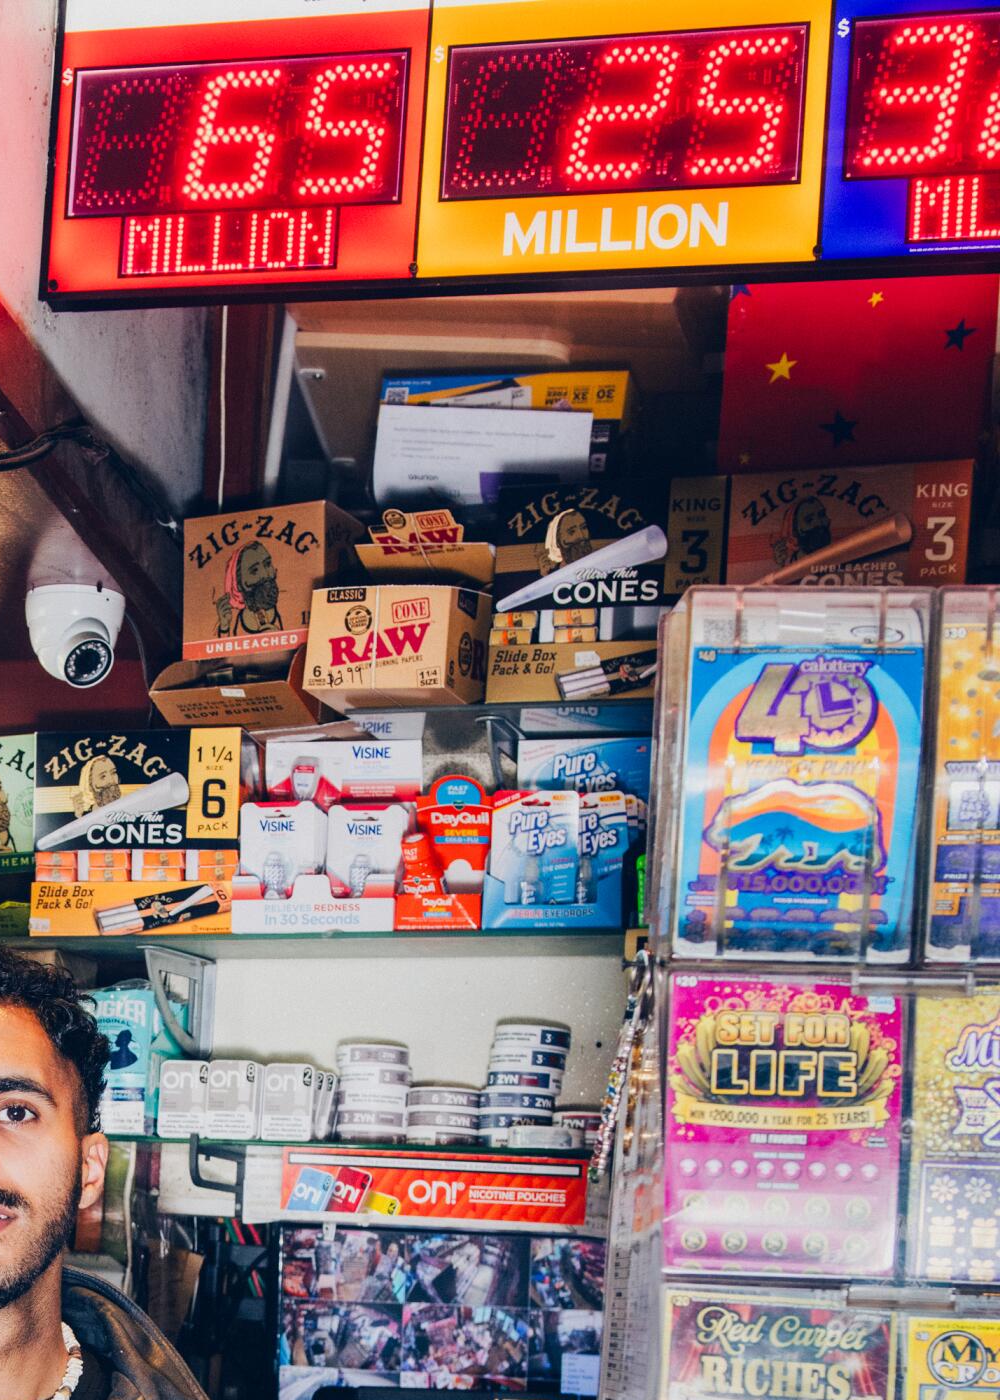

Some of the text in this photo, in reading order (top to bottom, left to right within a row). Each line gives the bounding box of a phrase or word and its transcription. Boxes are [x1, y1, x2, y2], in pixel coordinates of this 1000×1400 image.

[563, 37, 794, 182] 25
[63, 62, 393, 200] $ 65
[502, 203, 729, 257] MILLION
[124, 208, 334, 275] MILLION
[741, 474, 888, 527] ZIG-ZAG
[917, 483, 969, 498] KING
[508, 488, 643, 537] ZIG-ZAG
[671, 498, 722, 512] KING
[418, 513, 450, 529] CONE
[189, 515, 319, 570] ZIG-ZAG
[925, 516, 956, 562] 3
[680, 530, 709, 573] 3
[811, 562, 896, 574] UNBLEACHED
[920, 564, 957, 577] PACK
[329, 588, 365, 602] CLASSIC
[553, 580, 659, 605] CONES
[394, 599, 429, 622] CONE
[206, 634, 298, 654] UNBLEACHED
[329, 622, 431, 667] RAW
[495, 649, 557, 663] Slide Box
[312, 665, 322, 678] 6
[491, 662, 556, 676] Pack & Go!
[799, 660, 869, 677] calottery
[419, 677, 440, 688] SIZE
[45, 735, 167, 780] ZIG-ZAG
[352, 745, 392, 760] VISINE
[553, 752, 597, 778] Pure
[201, 778, 227, 819] 6
[198, 821, 229, 833] PACK
[259, 819, 296, 832] VISINE
[346, 822, 383, 837] VISINE
[431, 811, 490, 828] DayQuil
[509, 810, 549, 835] Pure
[86, 823, 184, 845] CONES
[444, 829, 479, 837] SEVERE
[529, 828, 568, 856] Eyes
[581, 829, 617, 856] Eyes
[38, 885, 95, 899] Slide Box
[422, 897, 453, 908] DayQuil
[35, 898, 93, 910] Pack & Go!
[264, 913, 360, 925] In 30 Seconds
[715, 1011, 851, 1048] SET FOR
[711, 1049, 859, 1098] LIFE
[563, 1118, 585, 1129] ZYN
[408, 1179, 566, 1206] on! NICOTINE POUCHES
[697, 1305, 868, 1357] Red Carpet
